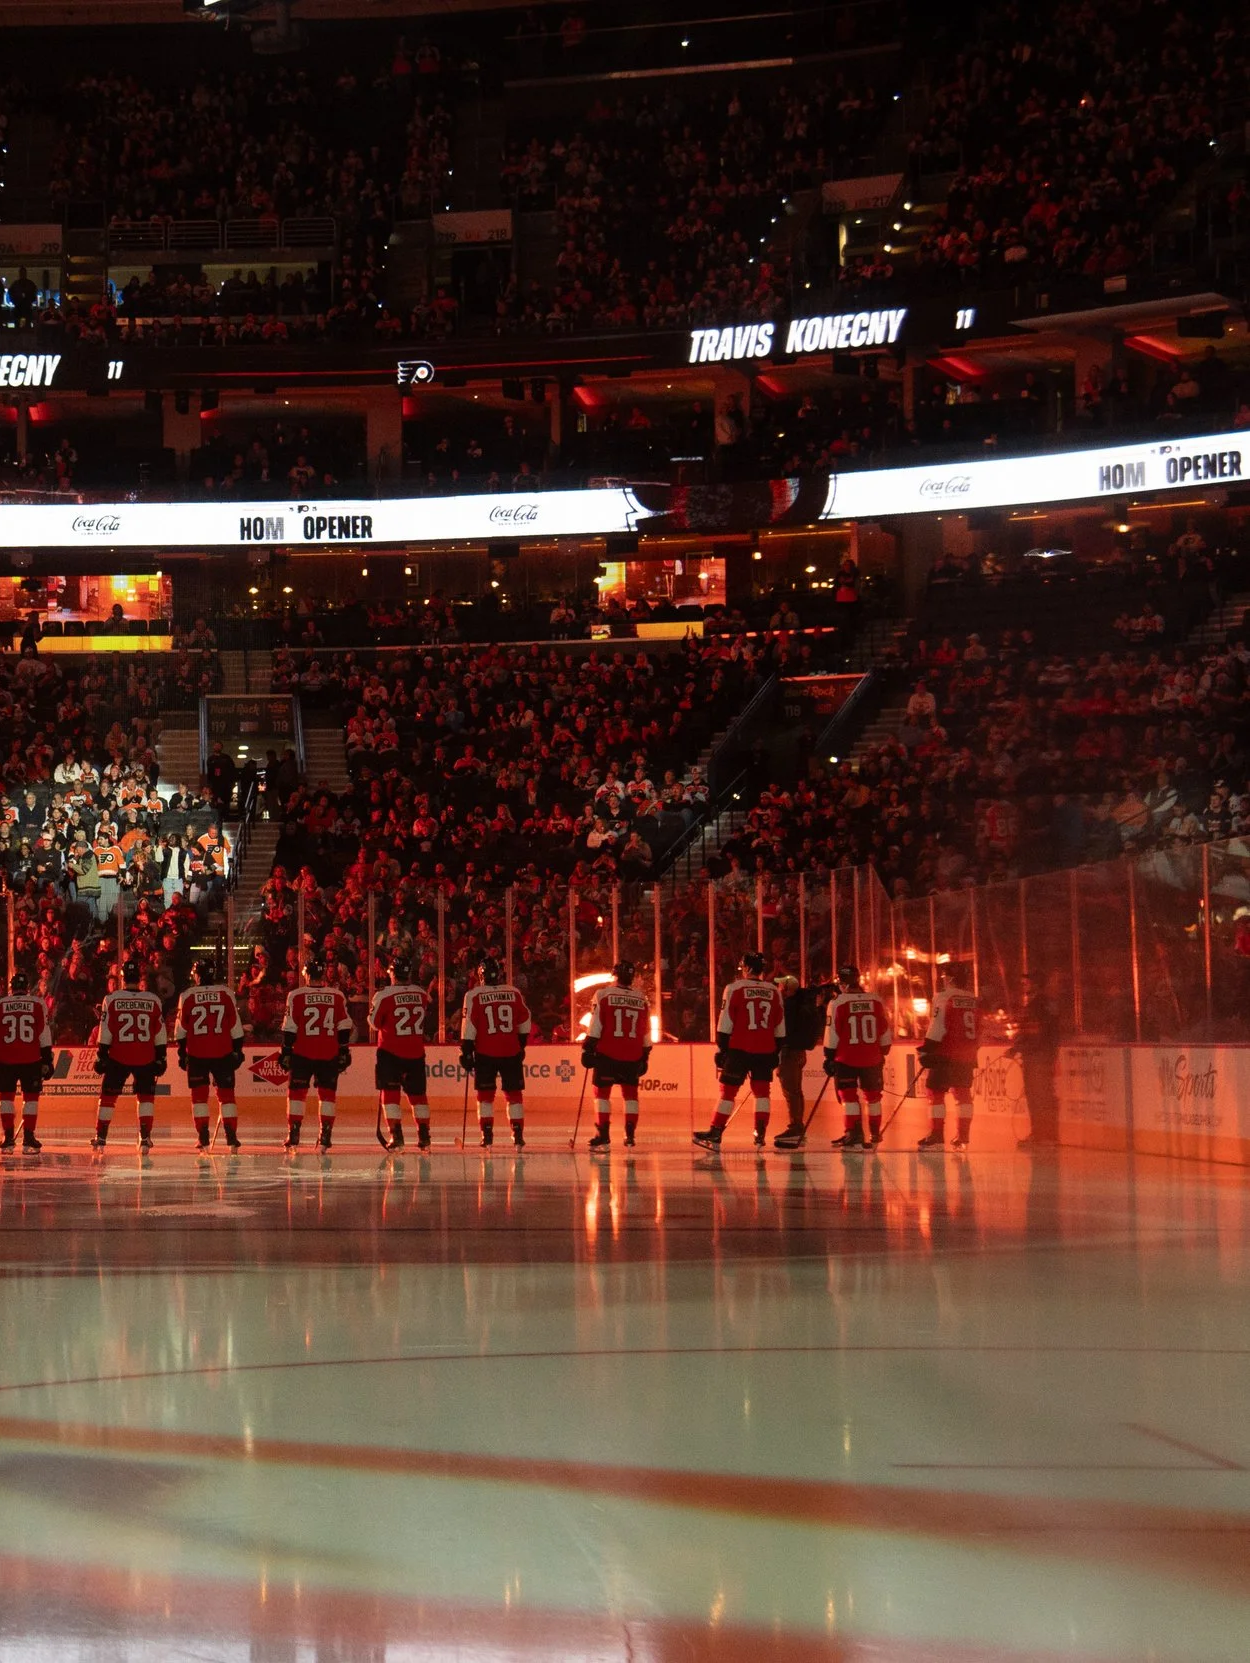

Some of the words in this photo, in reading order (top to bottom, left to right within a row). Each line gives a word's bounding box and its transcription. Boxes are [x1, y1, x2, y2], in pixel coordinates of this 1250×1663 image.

[41, 242, 59, 253] 219
[689, 322, 774, 363] TRAVIS
[785, 308, 906, 353] KONECNY
[955, 309, 975, 330] 11
[108, 361, 123, 379] 11
[1166, 450, 1242, 484] OPENER
[303, 515, 372, 540] OPENER
[813, 684, 836, 697] Rock
[210, 704, 235, 714] Hard
[236, 704, 260, 716] Rock
[211, 721, 226, 732] 119
[272, 721, 288, 732] 118
[5, 1002, 32, 1012] ANDRAE
[116, 1000, 153, 1010] GREBENKIN
[197, 991, 218, 1002] CATES
[307, 994, 333, 1004] SEELER
[481, 992, 514, 1003] HATHAWAY
[2, 1014, 35, 1044] 36
[118, 1013, 151, 1043] 29
[191, 1005, 226, 1035] 27
[303, 1007, 335, 1036] 24
[394, 1006, 426, 1036] 22
[485, 1005, 514, 1034] 19
[613, 1008, 639, 1038] 17
[745, 1001, 772, 1031] 13
[848, 1014, 877, 1045] 10
[963, 1011, 976, 1040] 9
